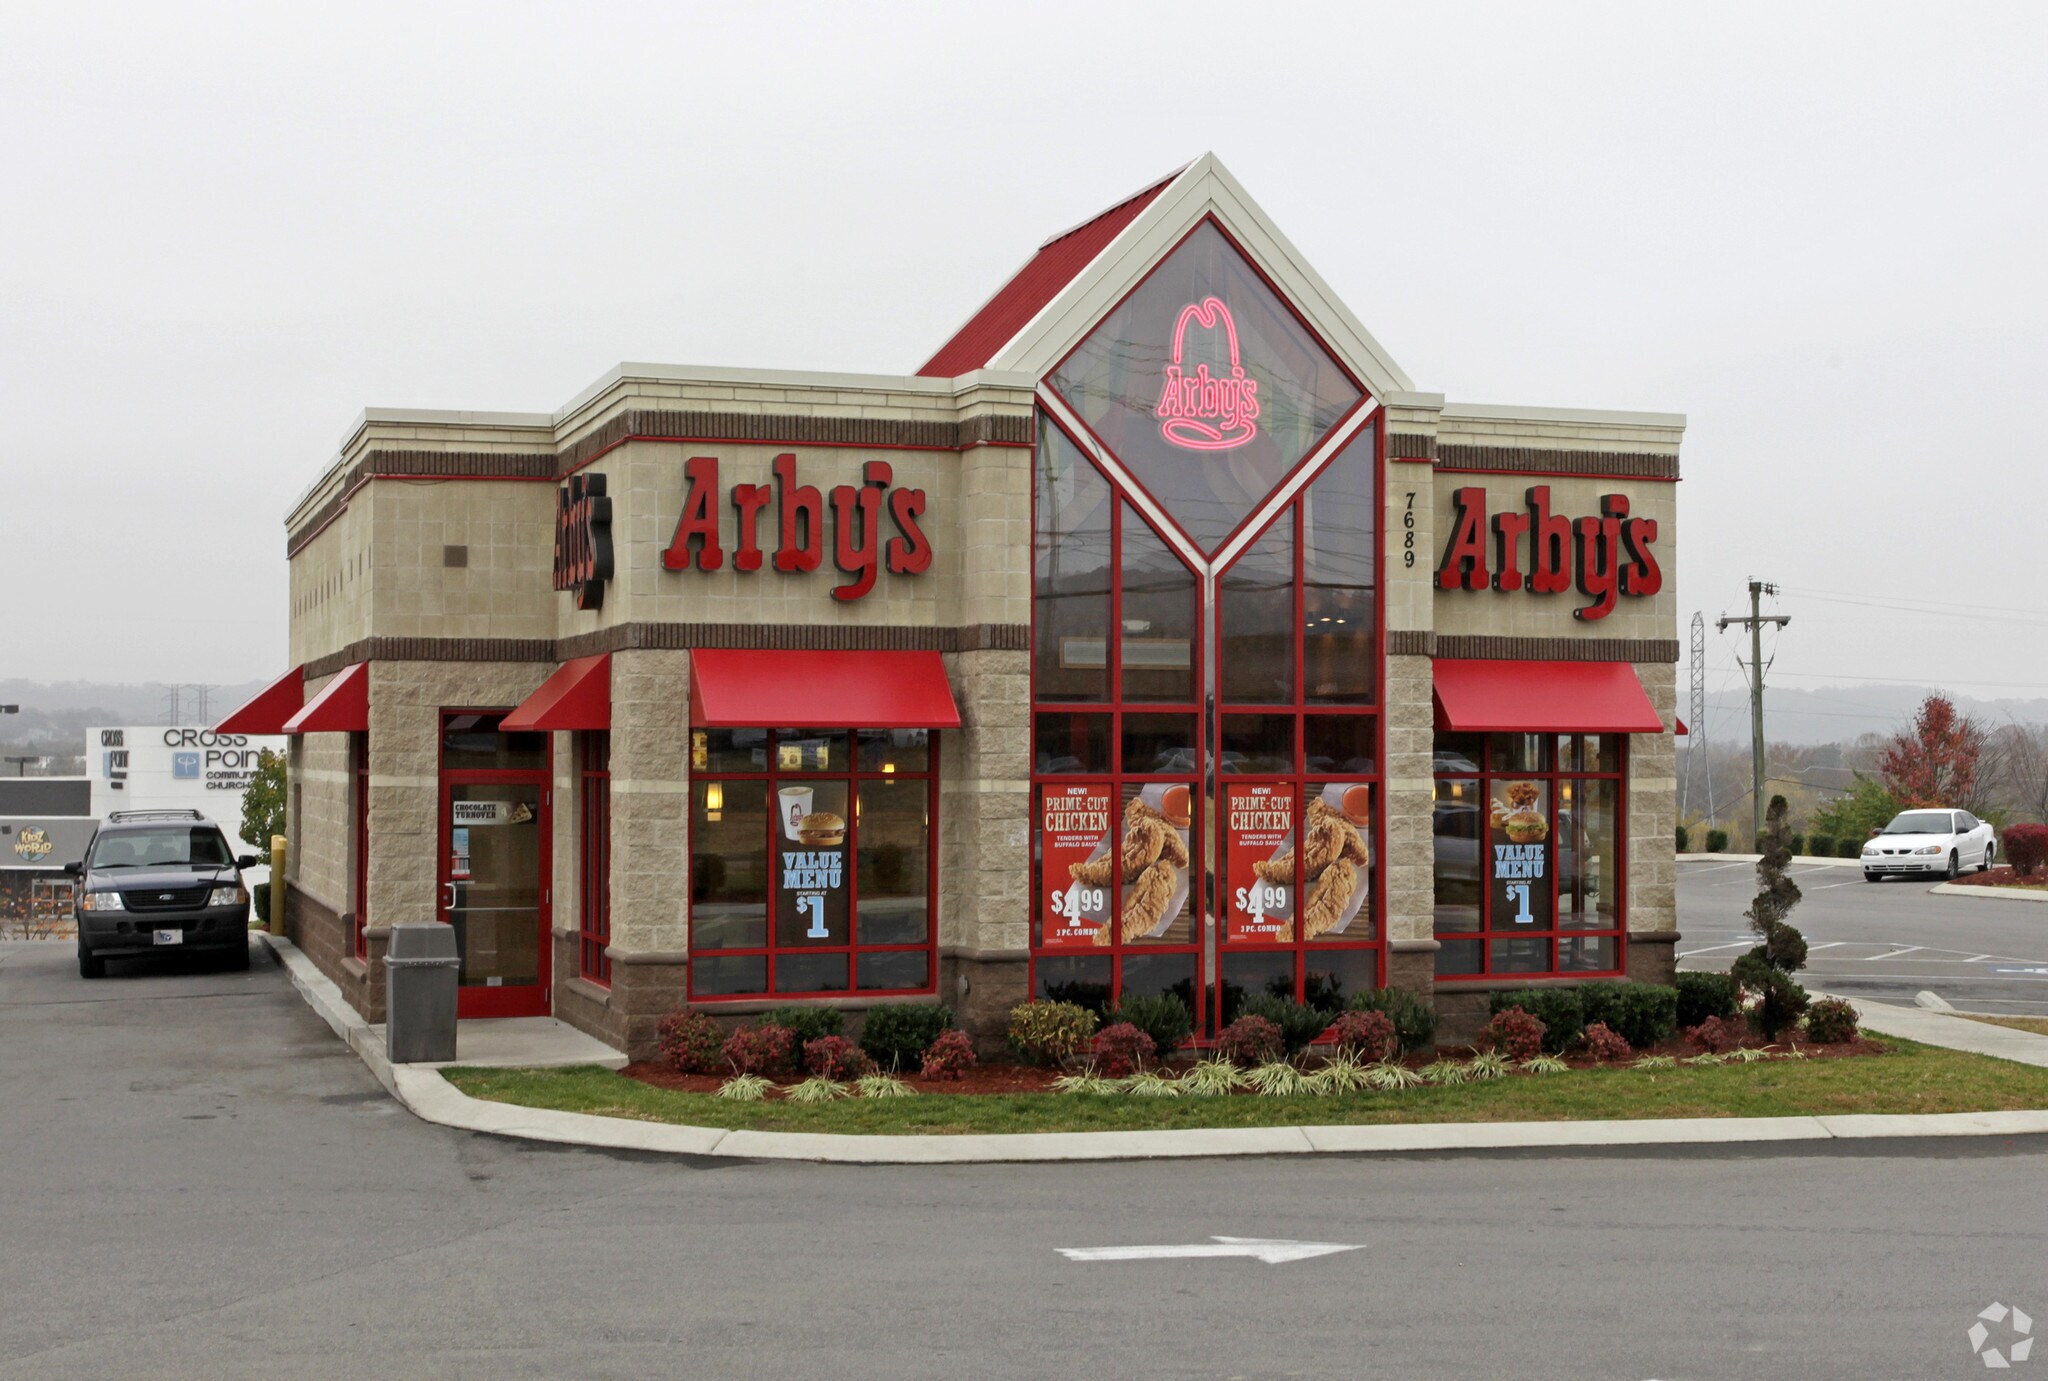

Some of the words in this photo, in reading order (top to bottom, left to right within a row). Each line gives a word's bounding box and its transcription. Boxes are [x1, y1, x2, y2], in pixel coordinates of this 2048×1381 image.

[1158, 364, 1259, 430] Arby's
[661, 453, 932, 601] Arby's
[1403, 492, 1416, 569] 7689
[1433, 485, 1662, 621] Arby's
[101, 729, 124, 747] CROSS
[163, 729, 248, 747] CROSS
[206, 750, 260, 768] POIN
[206, 781, 251, 790] CHURCH
[1067, 787, 1088, 795] NEW!
[1251, 787, 1272, 795] NEW!
[455, 804, 497, 812] CHOCOLATE
[1046, 797, 1109, 811] PRIME-CUT
[1231, 796, 1292, 810] PRIME-CUT
[455, 812, 497, 820] TURNOVER
[1045, 812, 1108, 832] CHICKEN
[1230, 811, 1291, 831] CHICKEN
[15, 842, 52, 854] WORLD
[1494, 844, 1545, 860] VALUE
[782, 851, 843, 869] VALUE
[1495, 860, 1545, 878] MENU
[783, 869, 842, 889] MENU
[1506, 884, 1533, 923] $1
[796, 895, 829, 938] $1
[1074, 928, 1099, 936] COMBO
